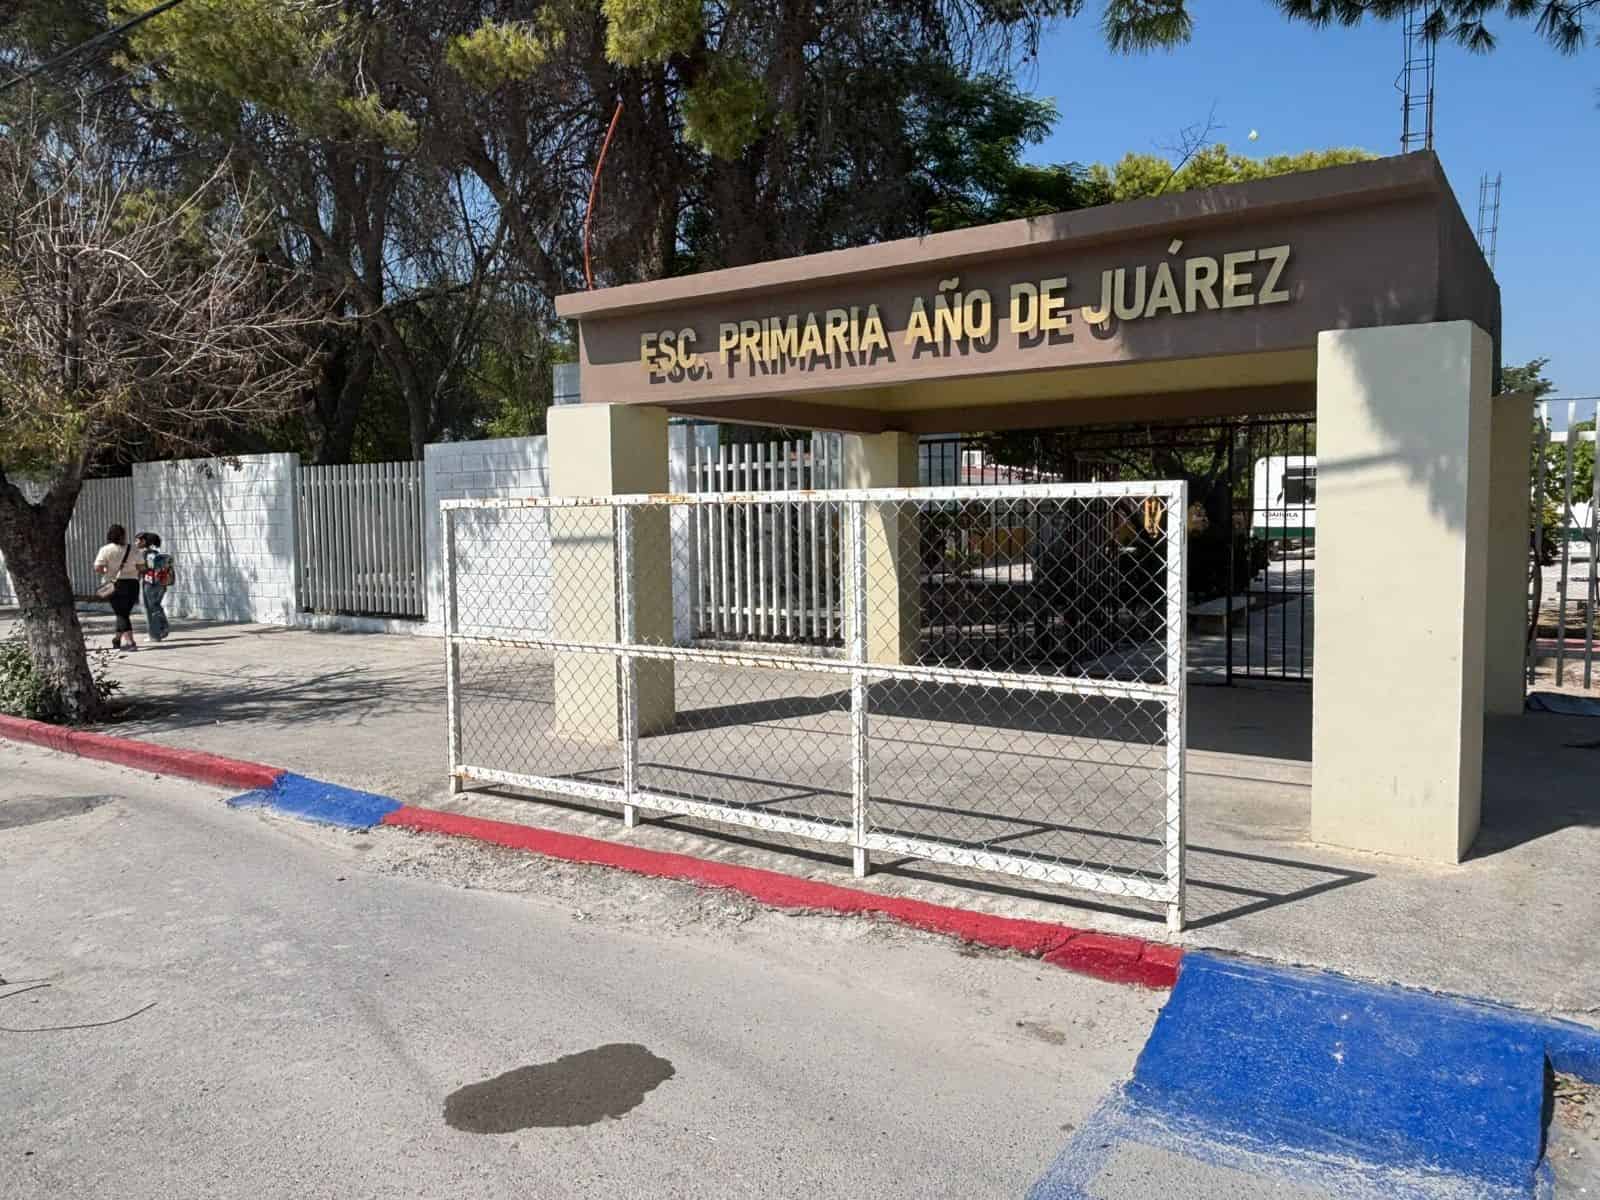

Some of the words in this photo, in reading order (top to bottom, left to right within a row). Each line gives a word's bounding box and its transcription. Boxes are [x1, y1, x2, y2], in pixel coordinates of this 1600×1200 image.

[719, 304, 889, 365] PRIMARIA
[904, 277, 991, 345] AÑO
[1009, 278, 1068, 333] DE
[1080, 239, 1291, 324] JUÁREZ
